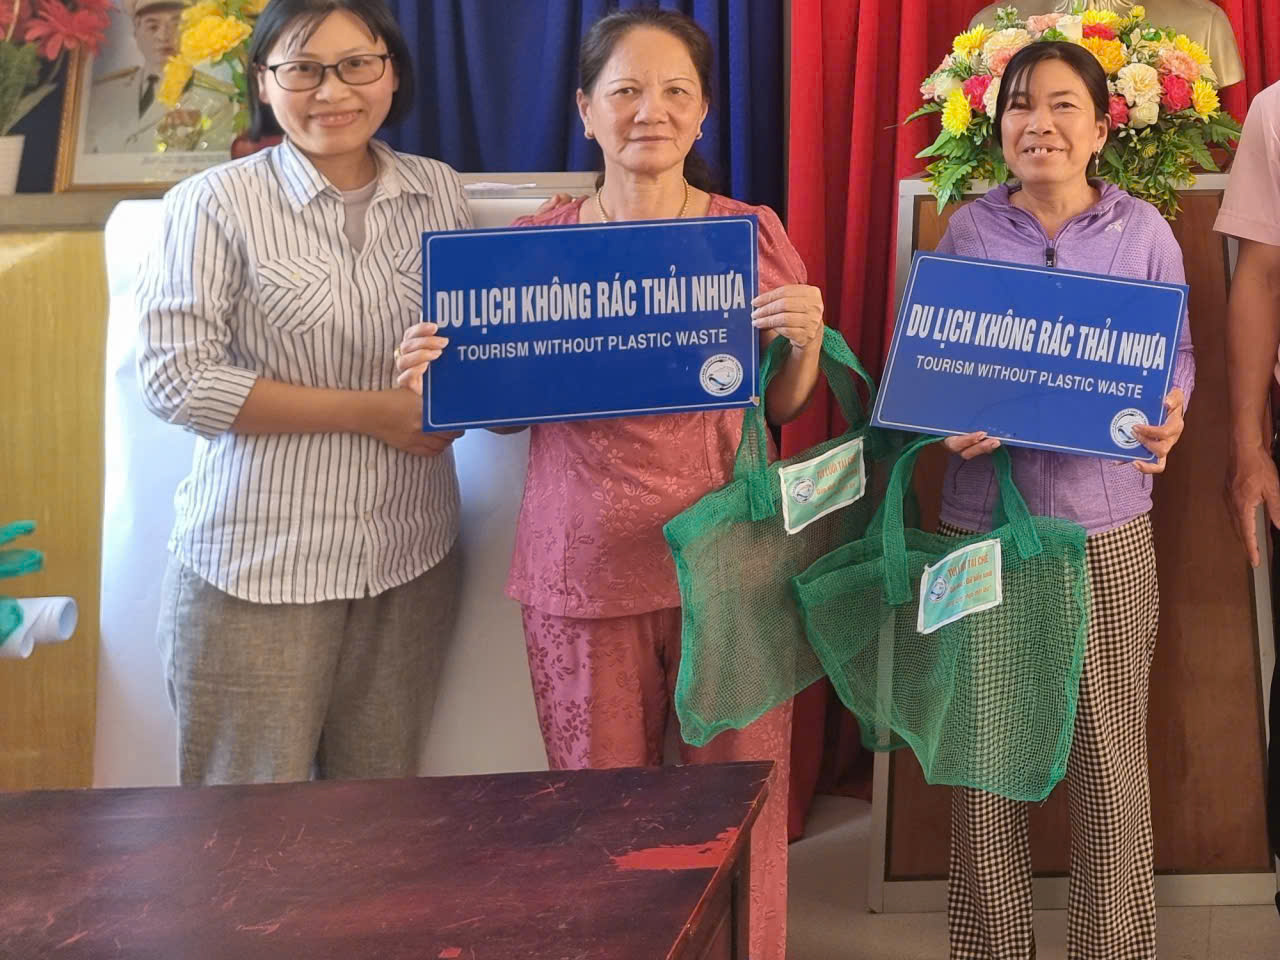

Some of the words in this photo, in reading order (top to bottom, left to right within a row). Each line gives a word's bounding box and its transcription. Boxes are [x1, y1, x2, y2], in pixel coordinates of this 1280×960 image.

[436, 290, 464, 329] DU
[470, 287, 515, 334] LỊCH
[522, 276, 591, 323] KHÔNG
[597, 273, 637, 318] RÁC
[642, 265, 686, 314] THẢI
[692, 270, 746, 319] NHỰA
[458, 343, 529, 361] TOURISM
[533, 337, 604, 356] WITHOUT
[608, 332, 671, 350] PLASTIC
[676, 329, 728, 345] WASTE
[906, 304, 931, 338] DU
[933, 307, 973, 348] LỊCH
[974, 309, 1036, 353] KHÔNG
[1037, 316, 1074, 357] RÁC
[1076, 318, 1118, 362] THẢI
[1117, 330, 1166, 376] NHỰA
[916, 355, 974, 376] TOURISM
[977, 365, 1037, 385] WITHOUT
[1039, 372, 1095, 392] PLASTIC
[1097, 381, 1143, 399] WASTE
